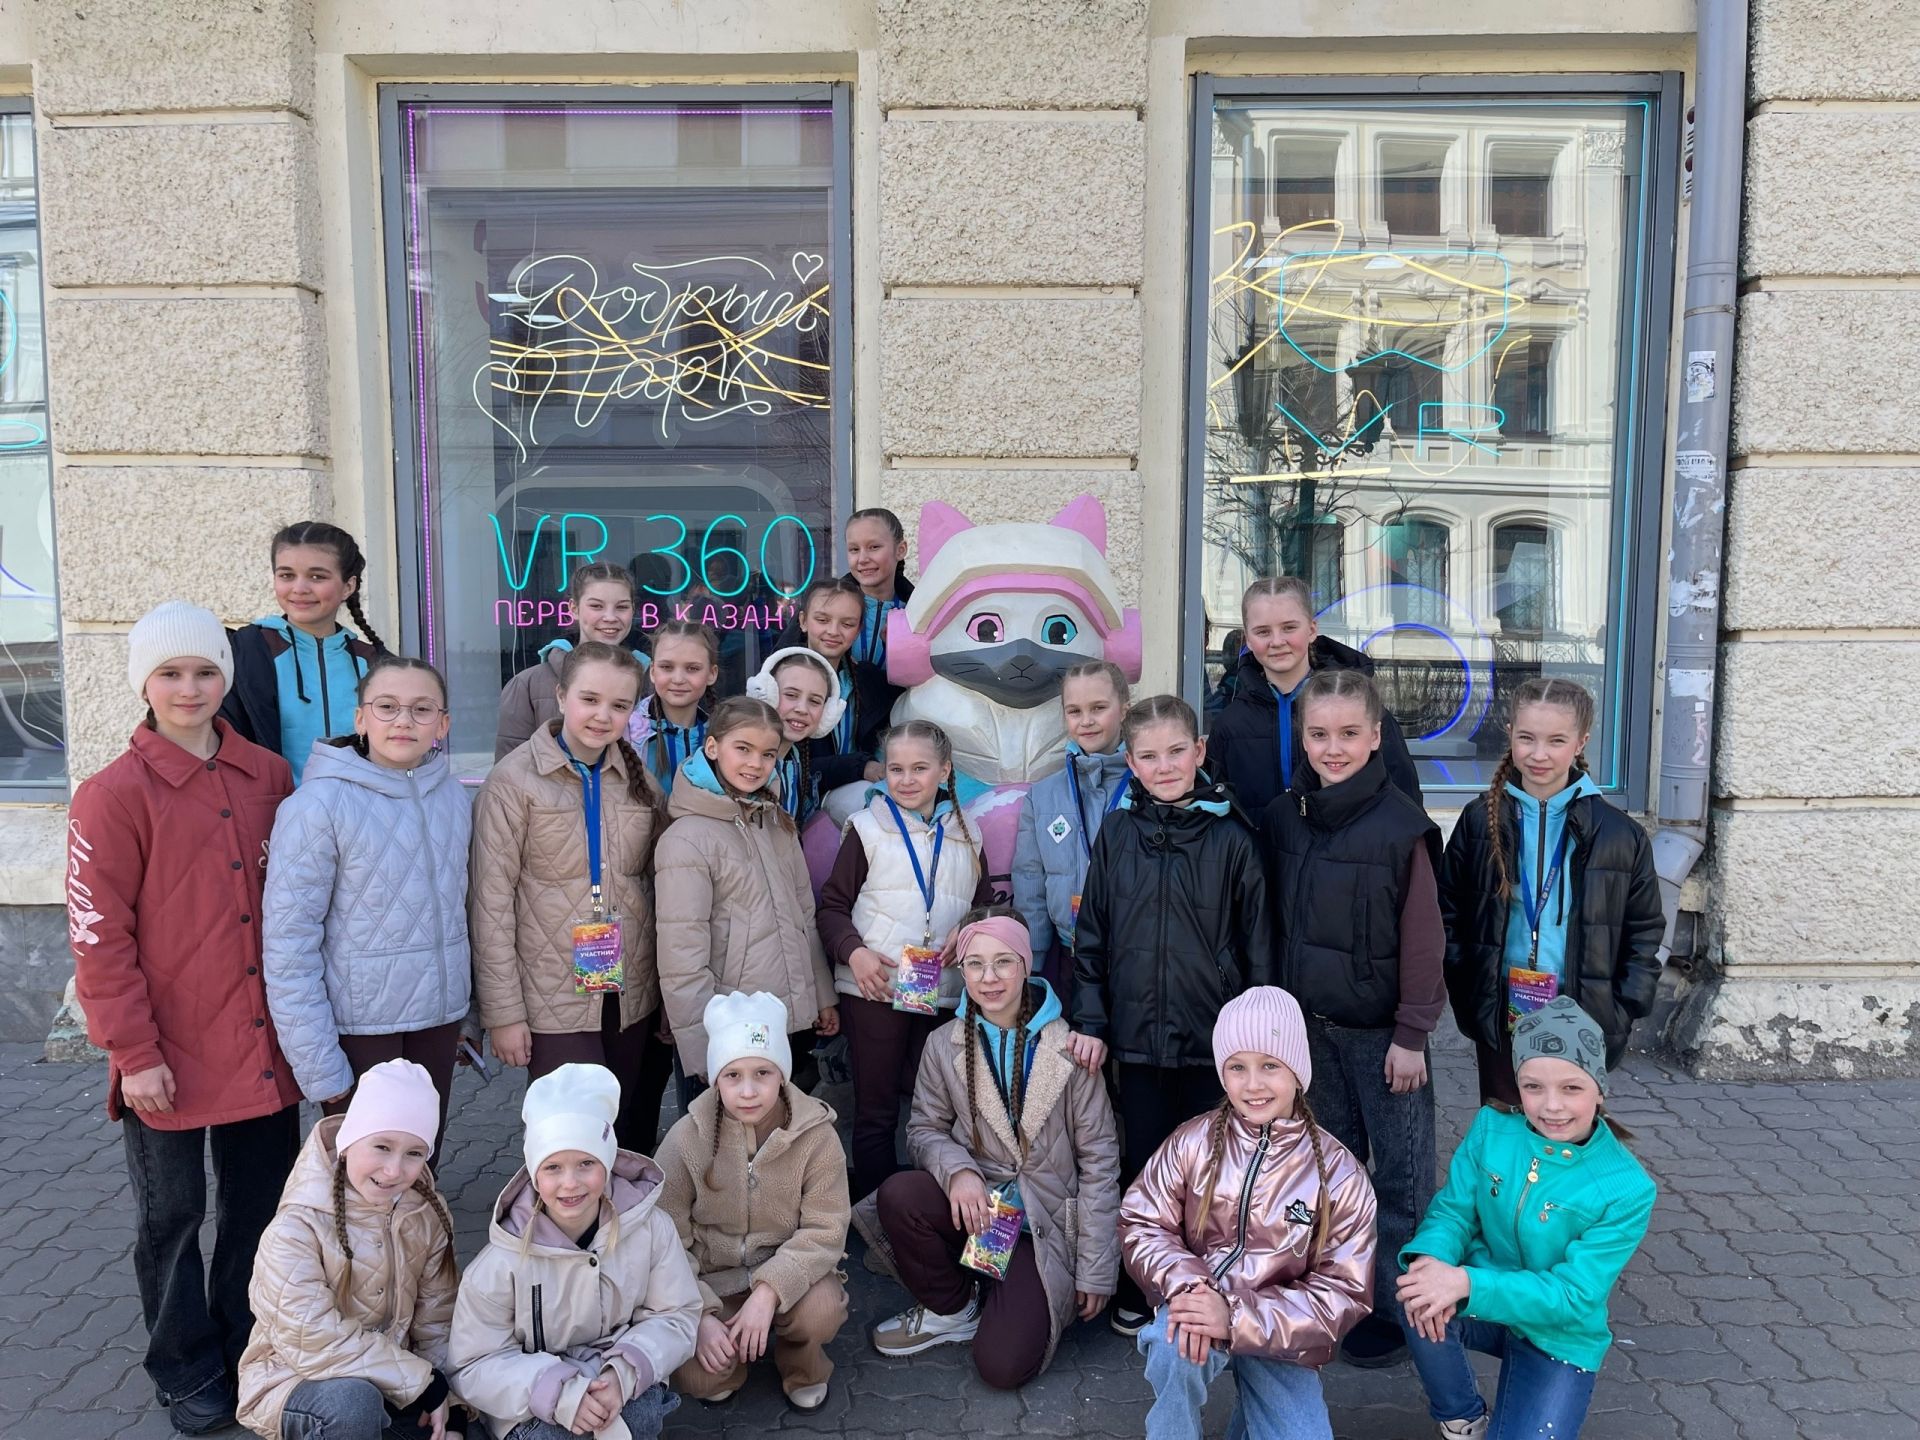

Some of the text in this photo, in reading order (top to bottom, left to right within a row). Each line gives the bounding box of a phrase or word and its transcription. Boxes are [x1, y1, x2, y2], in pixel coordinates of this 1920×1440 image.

[488, 513, 816, 598] VR 360
[641, 603, 660, 628] В
[580, 949, 615, 958] УЧАСТНИК
[1514, 992, 1549, 1003] УЧАСТНИК
